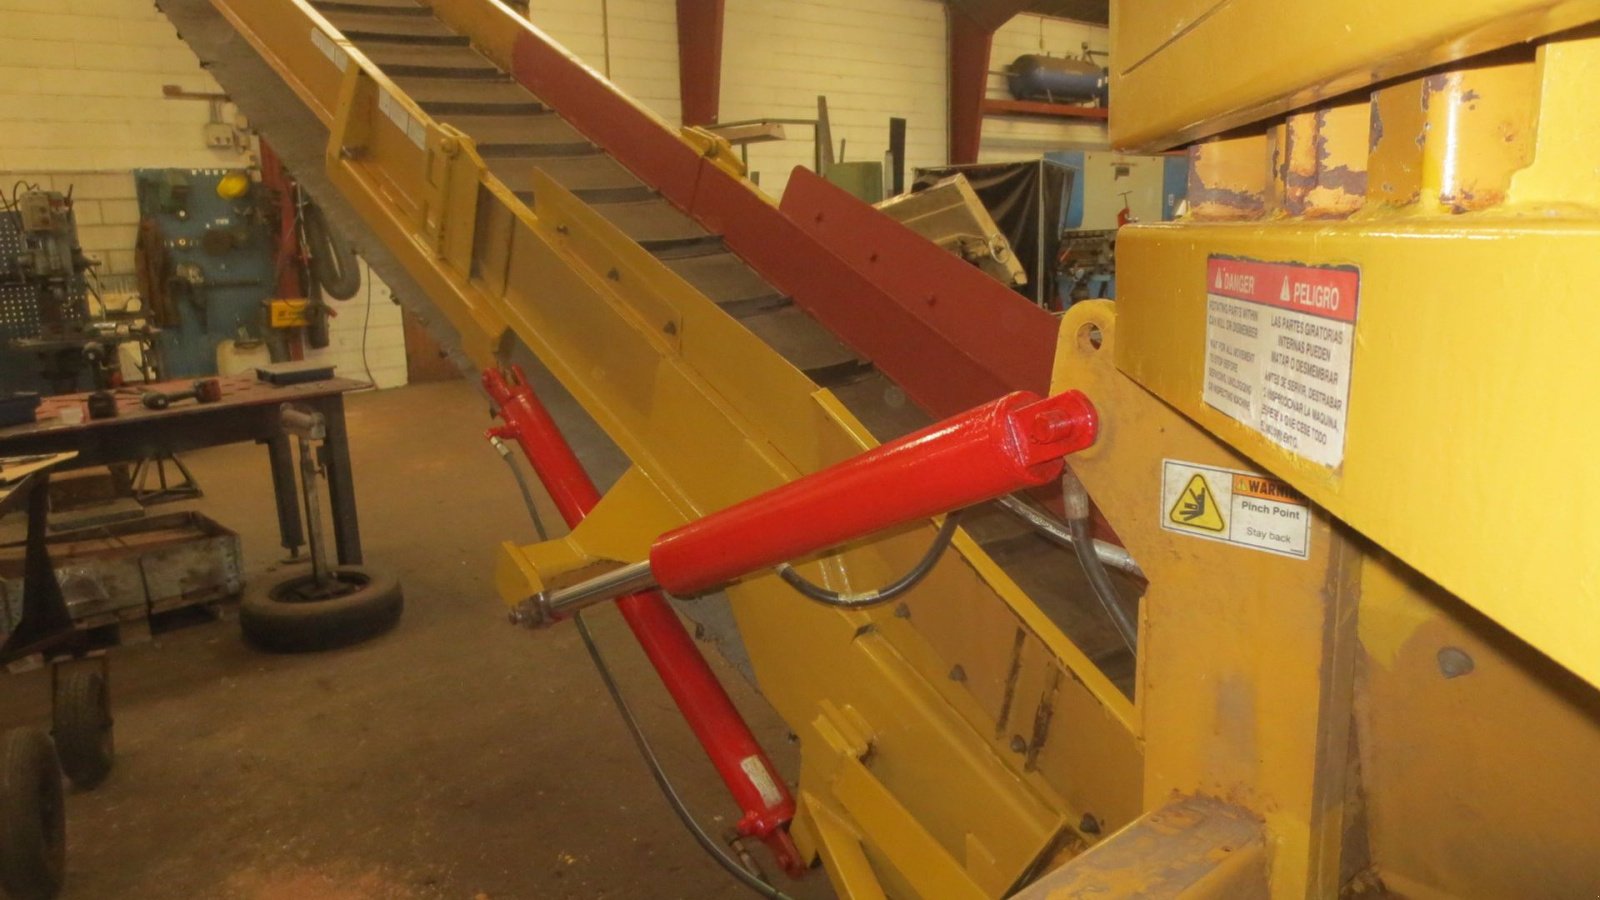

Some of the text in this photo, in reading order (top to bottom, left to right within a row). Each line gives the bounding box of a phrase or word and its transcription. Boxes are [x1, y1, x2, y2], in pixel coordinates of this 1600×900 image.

[1224, 272, 1255, 294] DANGER
[1294, 282, 1339, 311] PELIGRO
[1271, 315, 1343, 345] LAS PARTES GIRATORIAS
[1278, 334, 1331, 362] INTERNAS PUEDEN
[1271, 351, 1289, 368] MATAR
[1296, 359, 1338, 386] DESMEMBRAR
[1241, 501, 1300, 520] Pinch Point
[1246, 526, 1291, 543] Stay back
